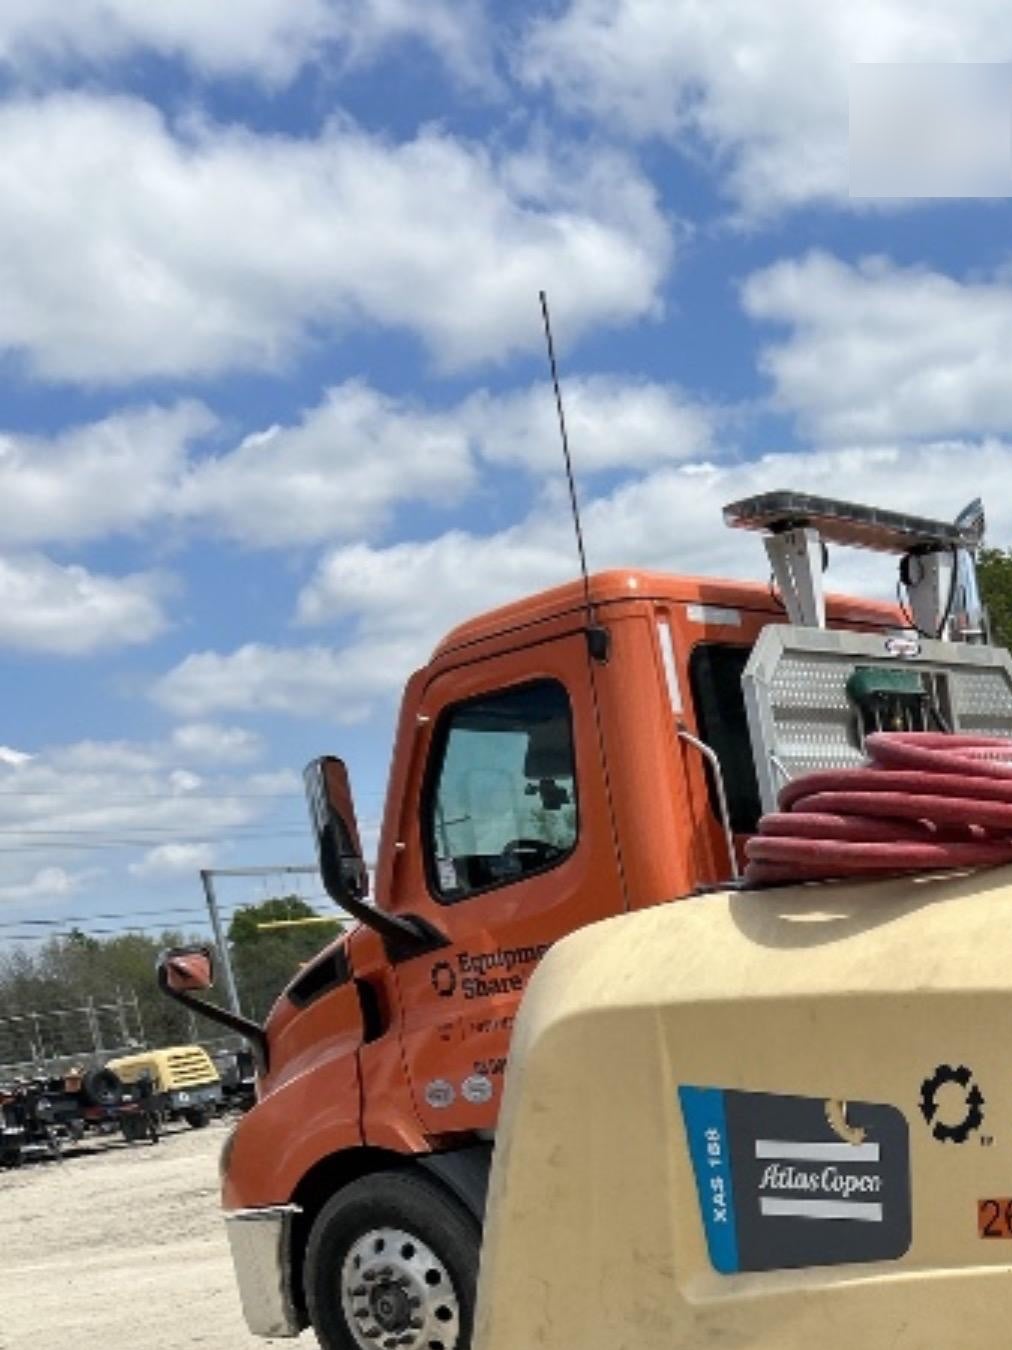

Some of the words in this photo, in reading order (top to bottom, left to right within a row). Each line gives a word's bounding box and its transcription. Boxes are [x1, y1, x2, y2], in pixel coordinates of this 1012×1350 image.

[462, 976, 523, 999] Share
[758, 1163, 820, 1193] Atlas
[710, 1176, 727, 1222] XAS
